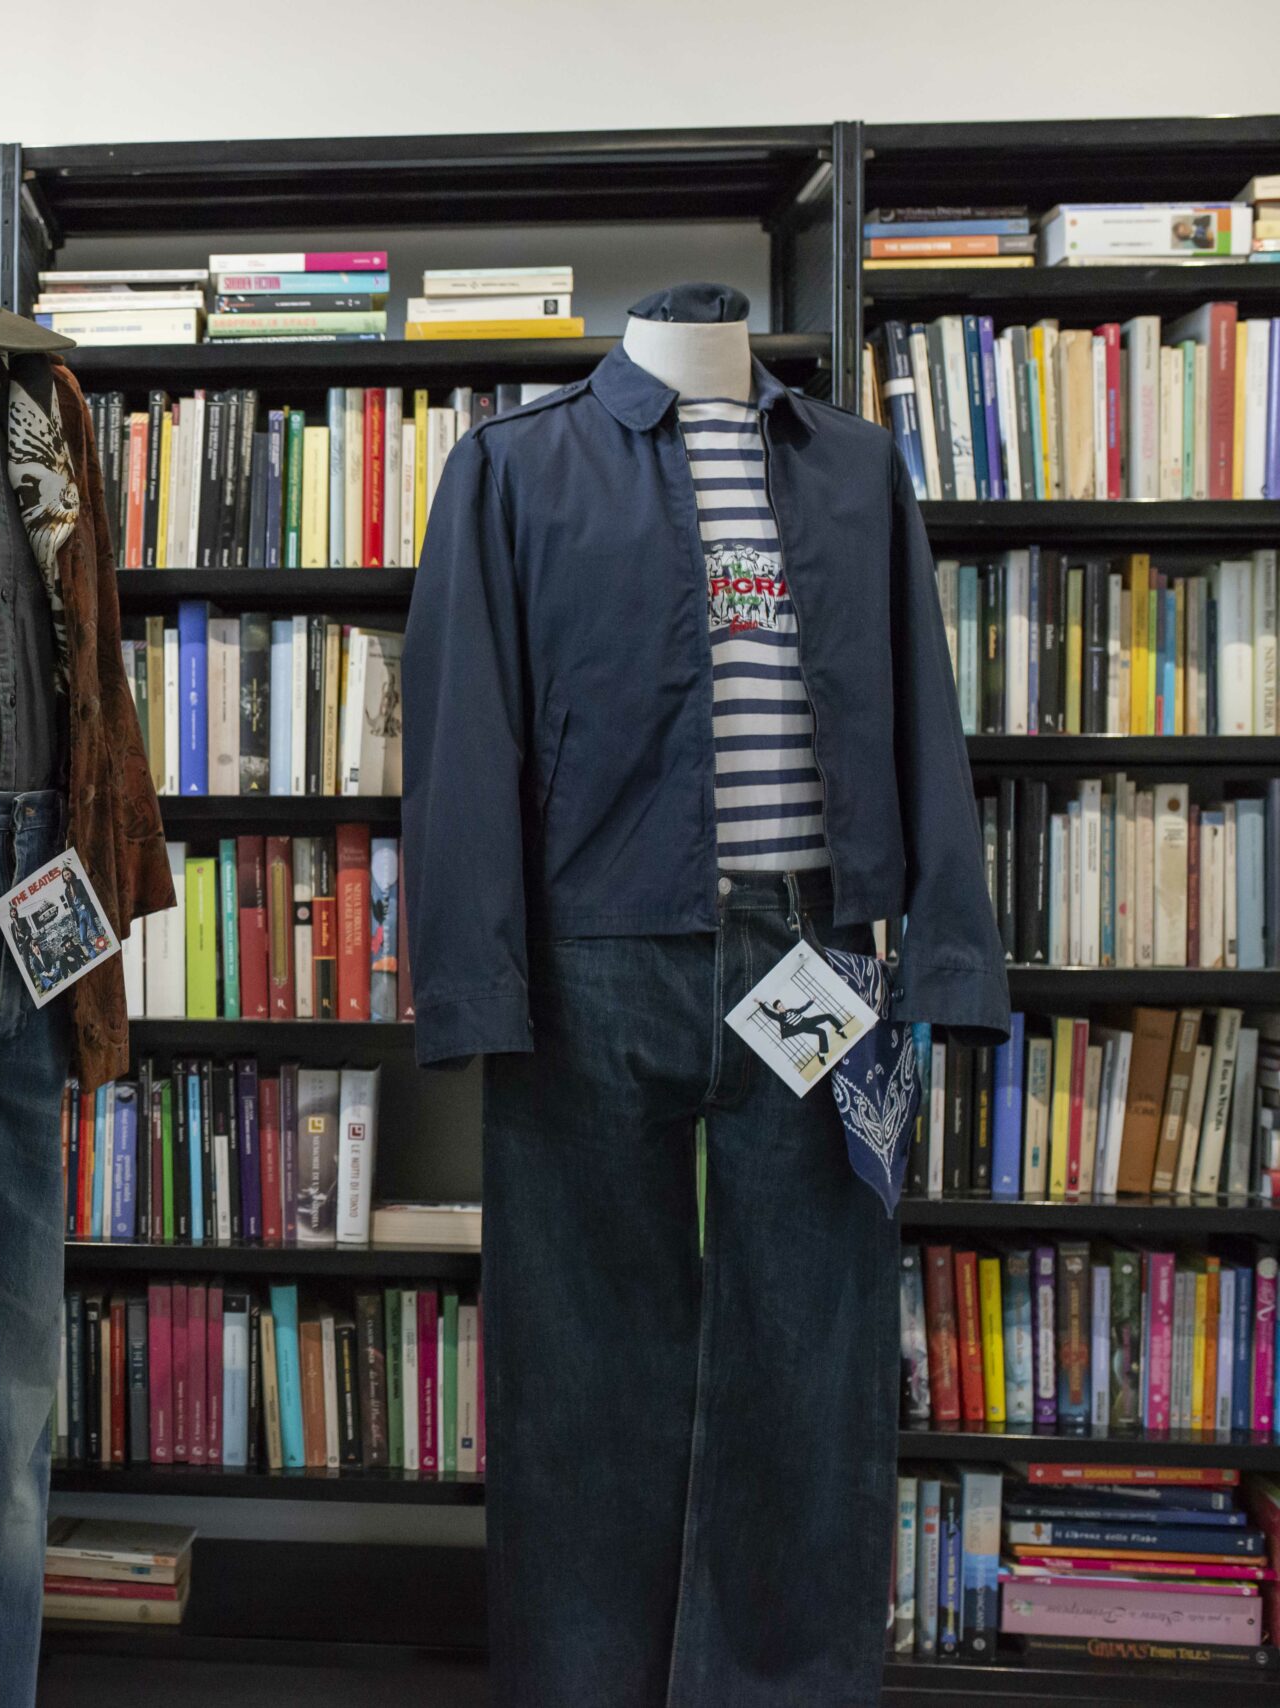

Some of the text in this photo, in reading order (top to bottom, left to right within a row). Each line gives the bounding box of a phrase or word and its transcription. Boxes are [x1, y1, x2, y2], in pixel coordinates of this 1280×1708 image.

[224, 276, 280, 290] SUDDEN FICTION
[11, 867, 62, 906] THE BEATLES
[312, 1135, 321, 1169] MEMORIE
[113, 1163, 123, 1190] pioggia
[122, 1155, 131, 1182] quando
[312, 1172, 320, 1180] DI
[349, 1144, 360, 1218] LE NOTTI DI TOKYO
[928, 1539, 937, 1617] HARRY POTTER
